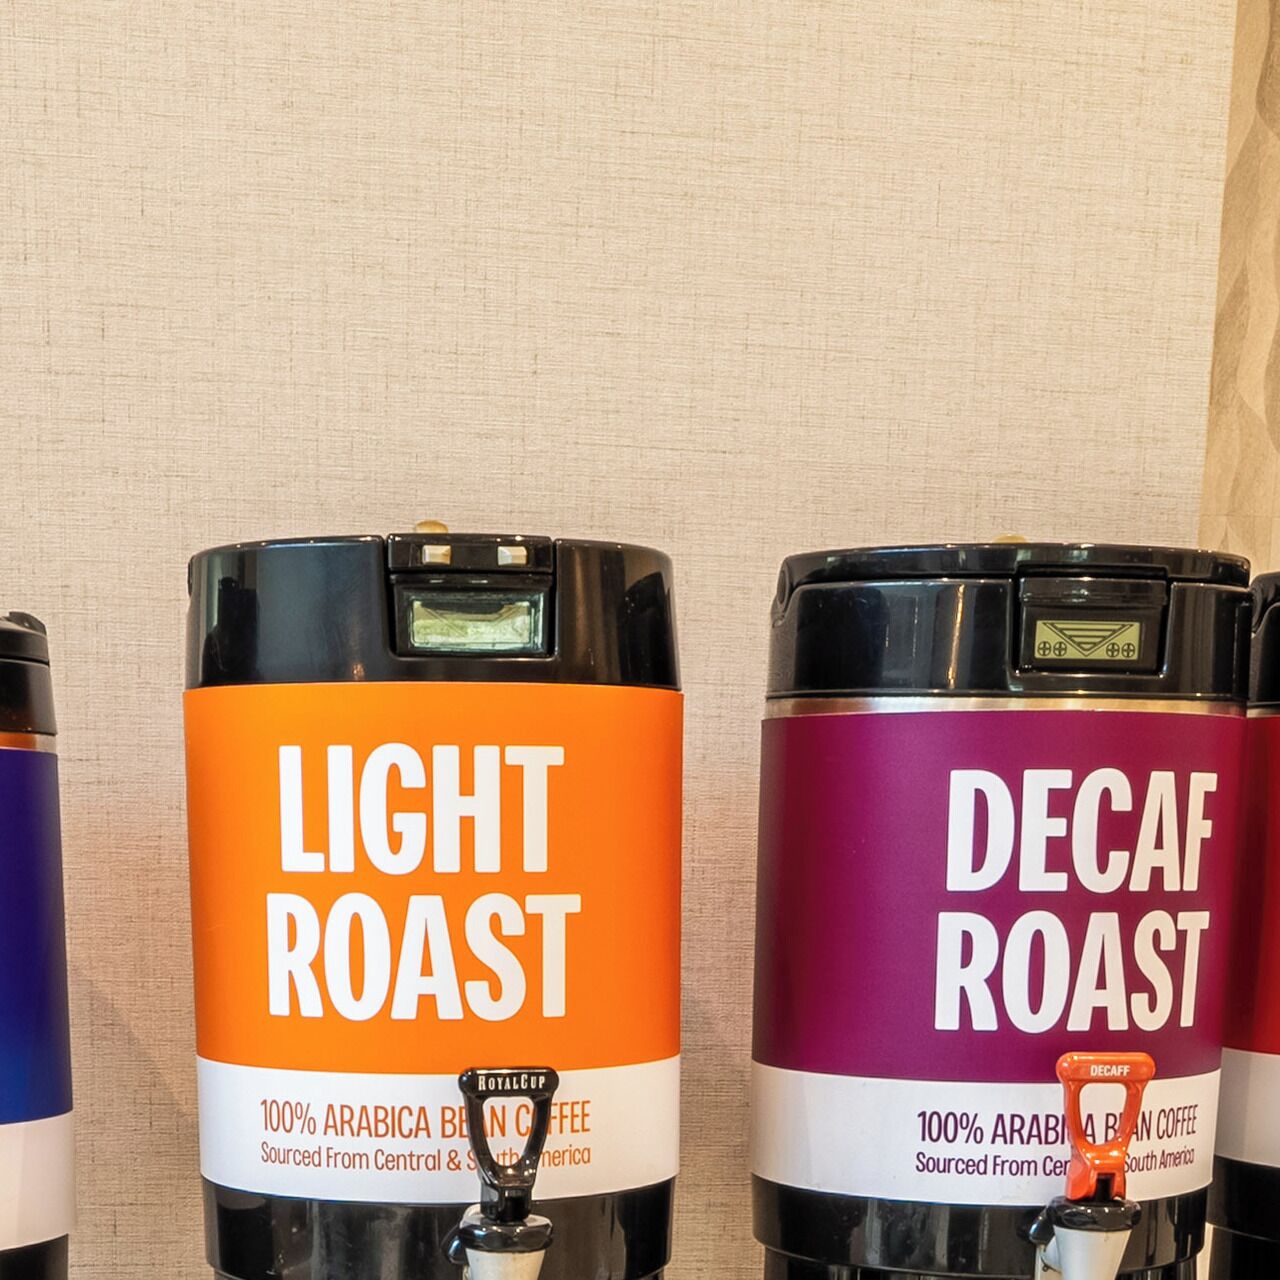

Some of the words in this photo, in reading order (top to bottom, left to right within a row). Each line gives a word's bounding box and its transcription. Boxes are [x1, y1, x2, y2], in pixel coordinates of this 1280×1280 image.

[277, 741, 565, 875] LIGHT
[945, 768, 1218, 893] DECAF
[266, 892, 582, 1023] ROAST
[934, 909, 1210, 1033] ROAST
[1090, 1064, 1130, 1077] DECAFF
[260, 1099, 316, 1135] 100%
[323, 1103, 432, 1139] ARABICA
[440, 1101, 507, 1139] BEN
[515, 1100, 591, 1138] CFFEE
[917, 1111, 984, 1144] 100%
[991, 1113, 1096, 1145] ARABIA
[1156, 1104, 1199, 1140] COFFEE
[260, 1141, 321, 1168] Sourced
[327, 1147, 370, 1171] From
[374, 1148, 441, 1172] Central
[447, 1148, 461, 1171] &
[540, 1144, 591, 1168] merica
[916, 1152, 988, 1175] Sourced
[992, 1155, 1037, 1176] From
[1159, 1146, 1195, 1171] America
